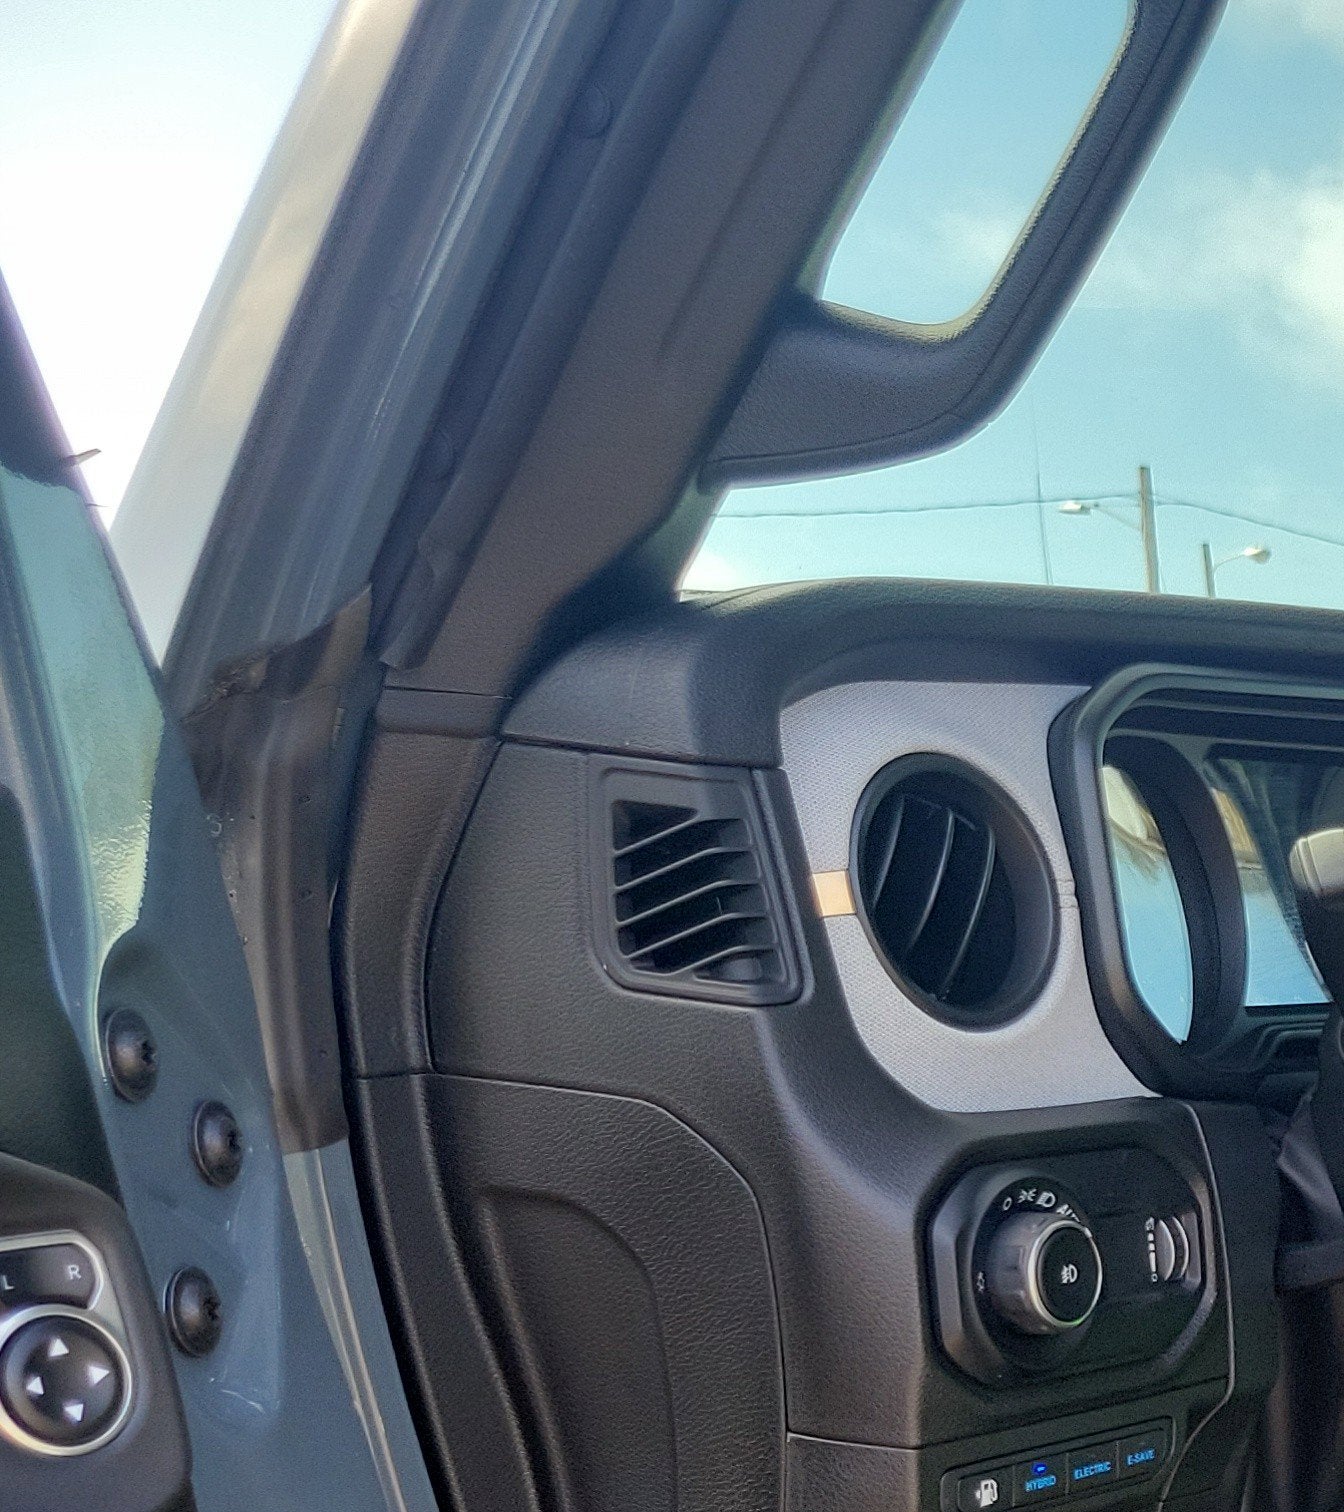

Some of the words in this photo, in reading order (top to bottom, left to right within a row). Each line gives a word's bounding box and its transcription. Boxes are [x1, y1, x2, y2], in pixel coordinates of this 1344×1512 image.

[1056, 1204, 1081, 1223] AUT
[67, 1264, 82, 1280] R
[1, 1274, 15, 1290] L
[1025, 1475, 1057, 1492] HYBRID
[1074, 1461, 1112, 1481] ELECTRIC
[1127, 1448, 1156, 1467] E-SAVE
